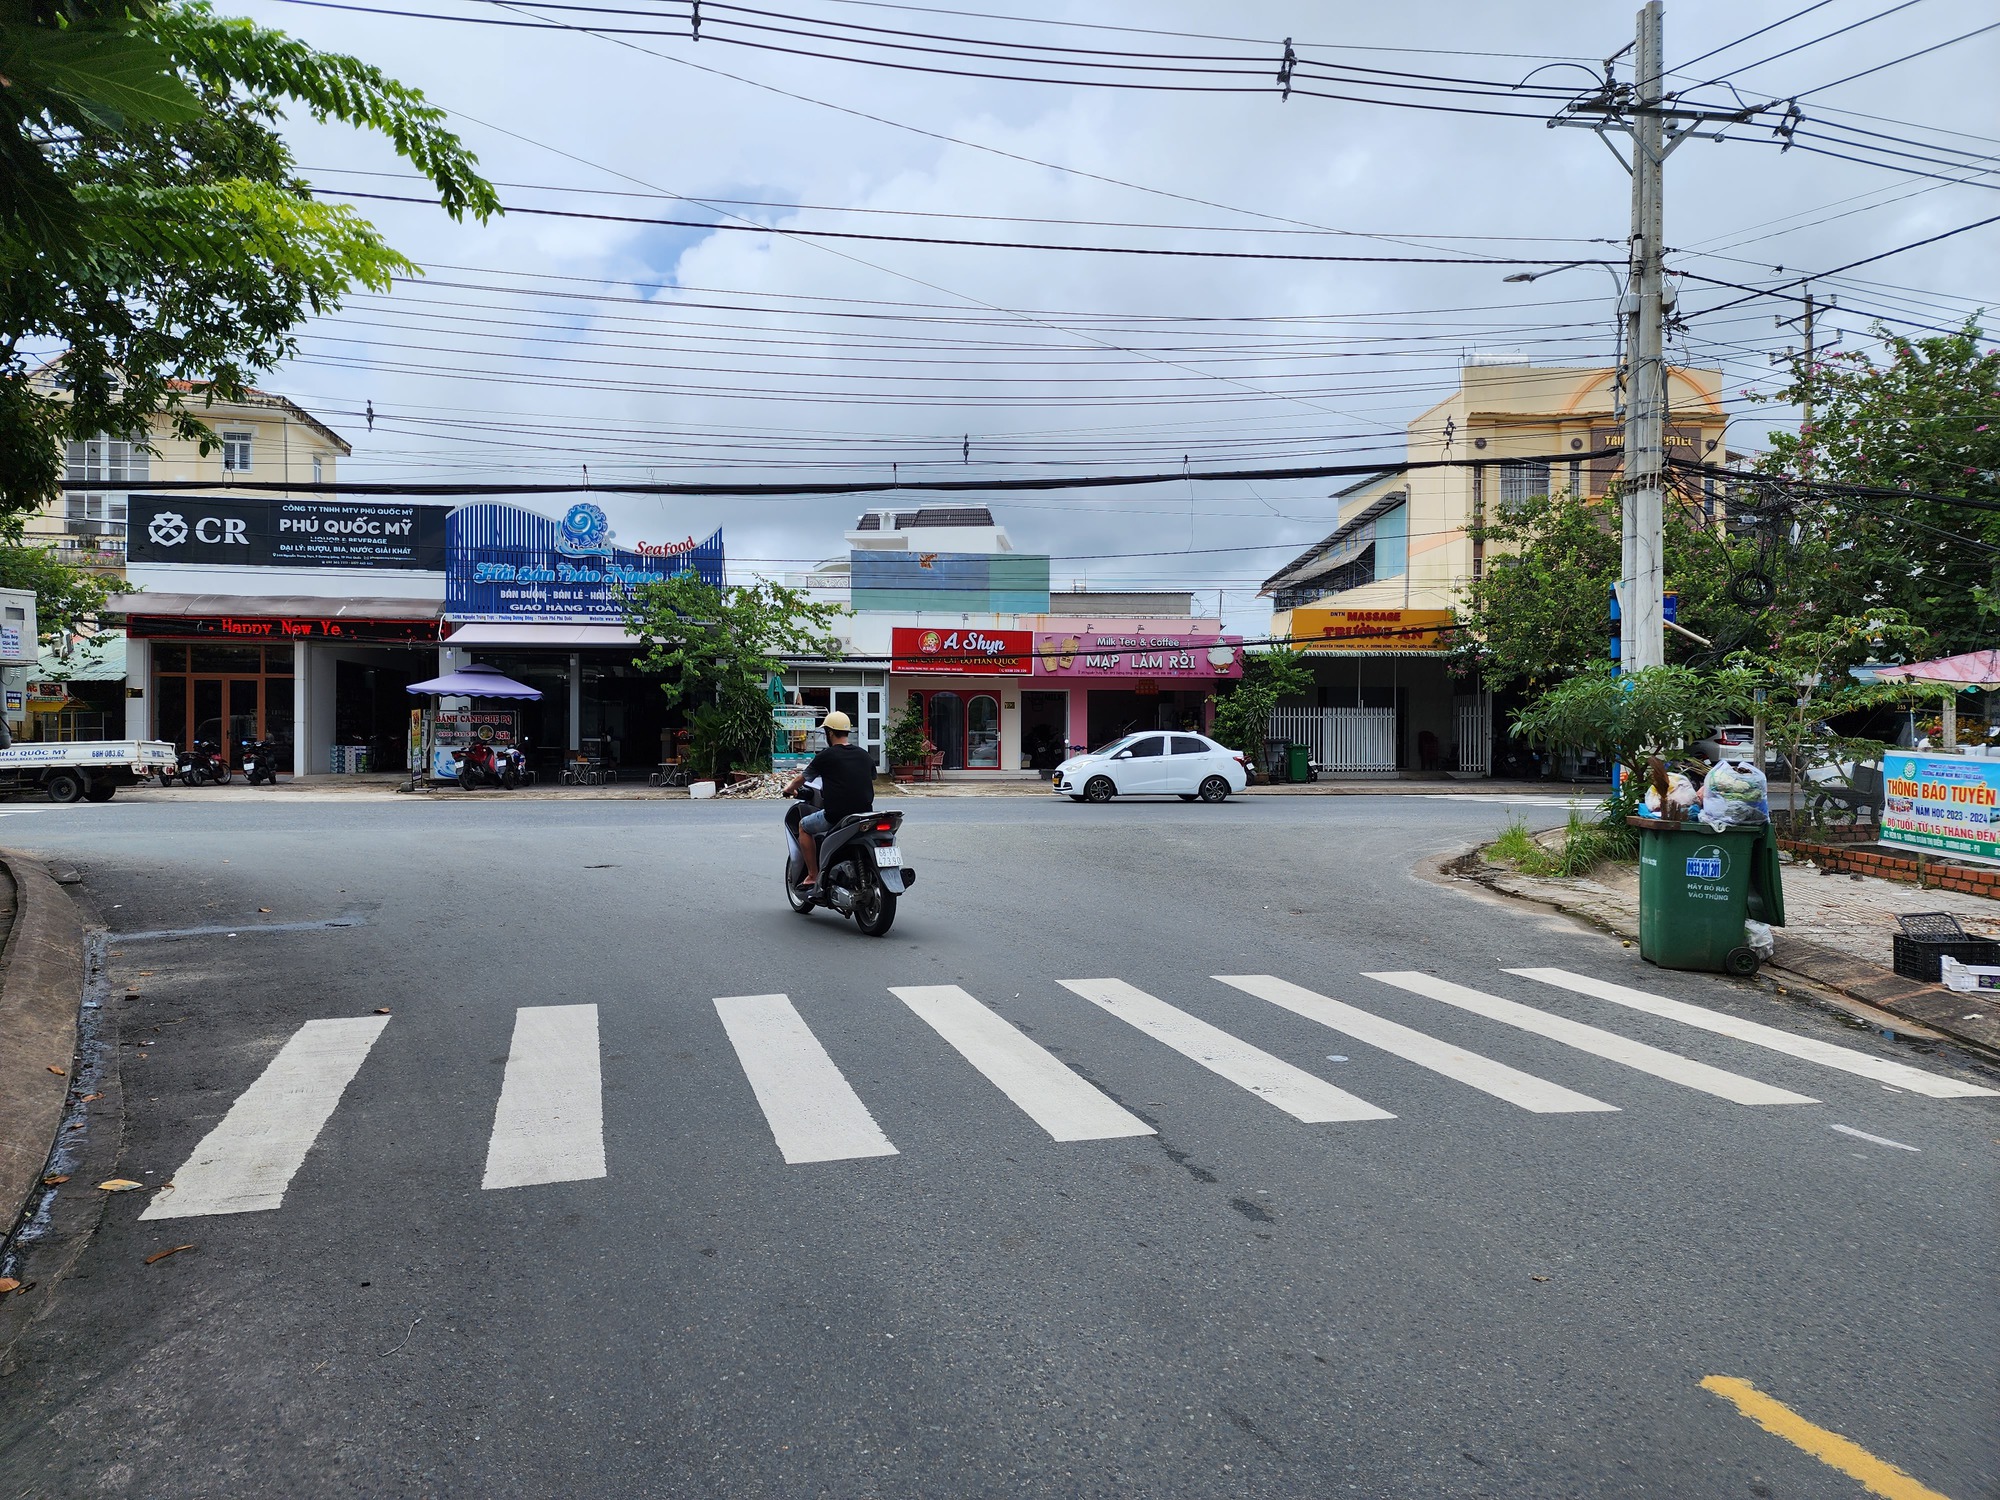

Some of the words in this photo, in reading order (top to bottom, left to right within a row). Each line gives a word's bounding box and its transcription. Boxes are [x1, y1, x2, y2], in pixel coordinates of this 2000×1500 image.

[282, 504, 306, 512] CÔNG
[360, 506, 376, 515] PHÚ
[378, 506, 401, 516] QUỐC
[402, 508, 413, 516] MỸ
[196, 518, 250, 545] CR
[279, 516, 319, 533] PHÚ
[324, 516, 381, 535] QUỐC
[385, 518, 413, 536] MỸ
[280, 544, 294, 553] ĐẠI
[307, 545, 332, 554] RƯỢU,
[334, 546, 349, 554] BIA,
[350, 546, 376, 554] NƯỚC
[376, 546, 391, 555] GIẢI
[392, 547, 412, 555] KHÁT
[635, 536, 696, 558] Seafood
[473, 562, 517, 584] Hải
[516, 564, 556, 585] Sản
[556, 562, 601, 585] Đảo
[501, 588, 519, 600] BÁN
[520, 588, 546, 600] BUÔN
[553, 588, 572, 600] BÁN
[510, 604, 542, 612] GIAO
[546, 602, 583, 612] HÀNG
[587, 602, 623, 613] TOÀN
[1346, 612, 1402, 622] MASSAGE
[222, 618, 273, 635] Happy
[282, 619, 312, 636] New
[320, 620, 341, 637] Ye
[1322, 622, 1393, 641] TRƯỜNG
[1397, 627, 1425, 641] AN
[944, 631, 961, 650] A
[963, 632, 1006, 656] Shyn
[1097, 637, 1117, 647] Milk
[1119, 638, 1137, 647] Tea
[1139, 638, 1146, 647] &
[1150, 638, 1180, 647] Coffee
[1168, 650, 1196, 669] RỒI
[436, 713, 458, 723] BÁNH
[460, 714, 483, 723] CANH
[482, 714, 500, 726] GHẸ
[20, 748, 49, 756] QUỐC
[1887, 778, 1919, 799] THÔNG
[1922, 781, 1947, 801] BÁO
[1951, 782, 1997, 806] TUYỂN
[1916, 804, 1931, 817] NĂM
[1932, 808, 1945, 821] HỌC
[1946, 808, 1963, 821] 2023
[1970, 812, 1988, 823] 2024
[1887, 818, 1896, 832] ĐỘ
[1897, 817, 1916, 832] TUỔI:
[1918, 820, 1929, 833] TỪ
[1930, 824, 1941, 835] 15
[1944, 825, 1974, 840] THÁNG
[1976, 828, 1997, 843] ĐẾN
[879, 848, 897, 857] 68-P1
[1688, 862, 1700, 876] 0933
[1688, 882, 1703, 891] HÃY
[1704, 884, 1715, 892] BỎ
[1688, 891, 1704, 899] VÀO
